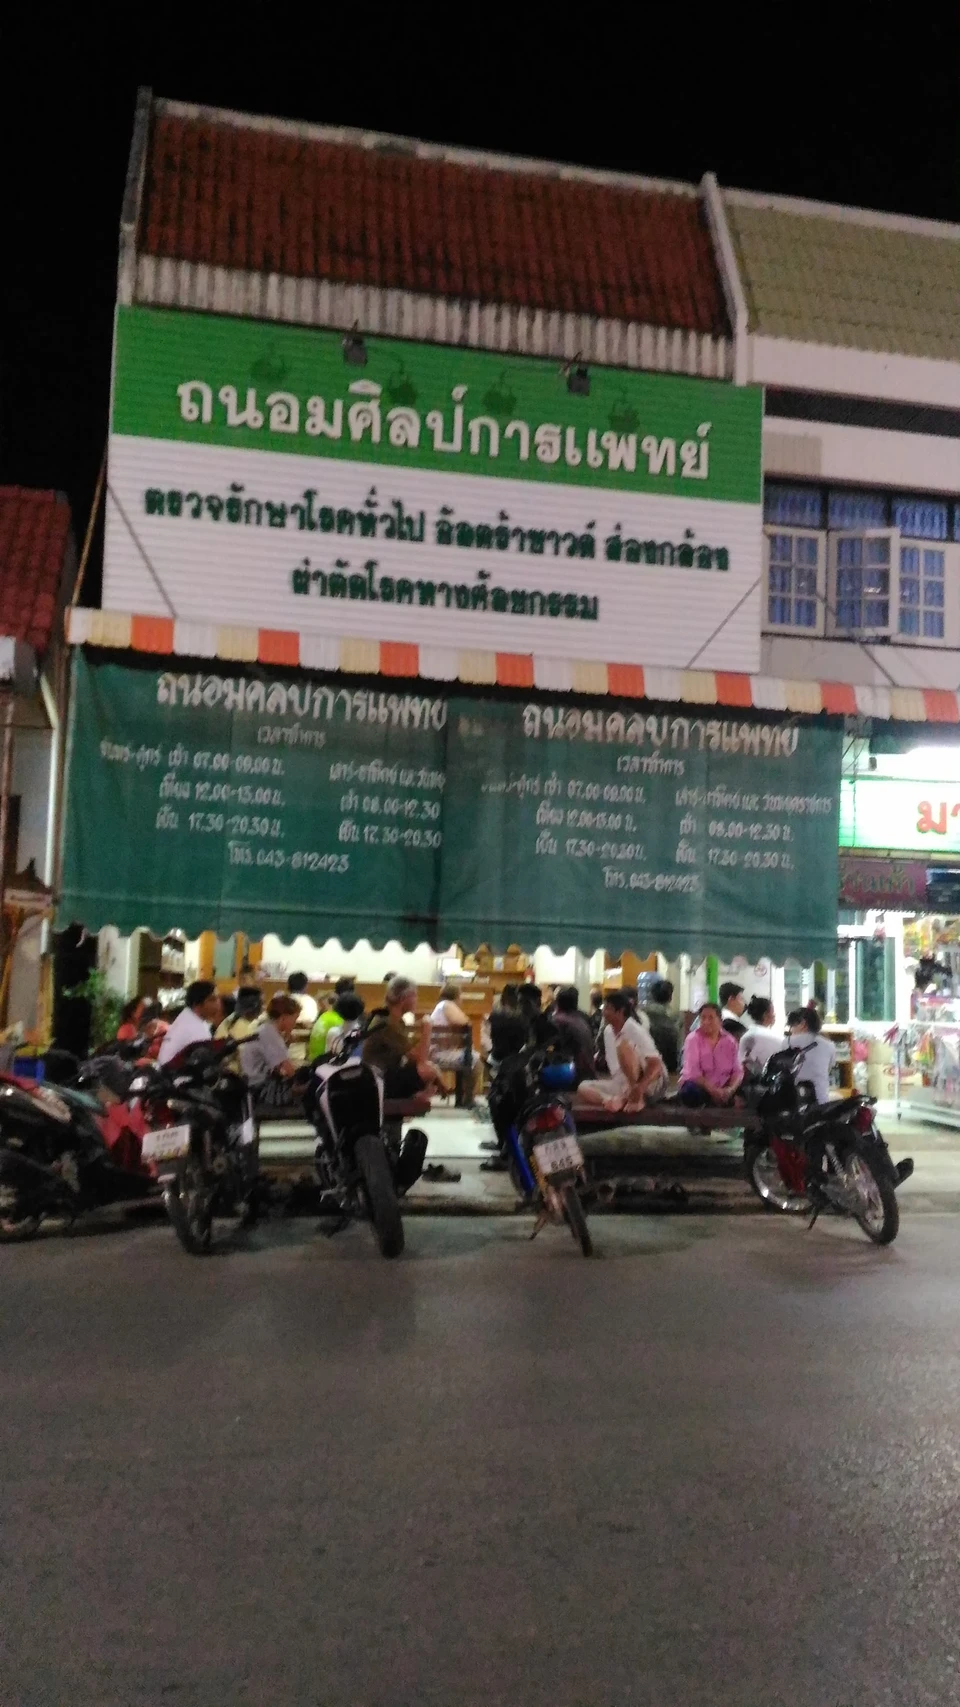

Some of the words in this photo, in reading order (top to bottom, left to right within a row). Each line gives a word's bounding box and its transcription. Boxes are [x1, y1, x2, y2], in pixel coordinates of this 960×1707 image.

[176, 379, 711, 480] ถนอมศิลป์การแพทย์
[144, 484, 425, 542] ตรวจรักษาโรคทั่วไป
[604, 522, 730, 571] ส่องกล้อง
[291, 557, 600, 621] ผ่าตัดโรคทางศัลยกรรม
